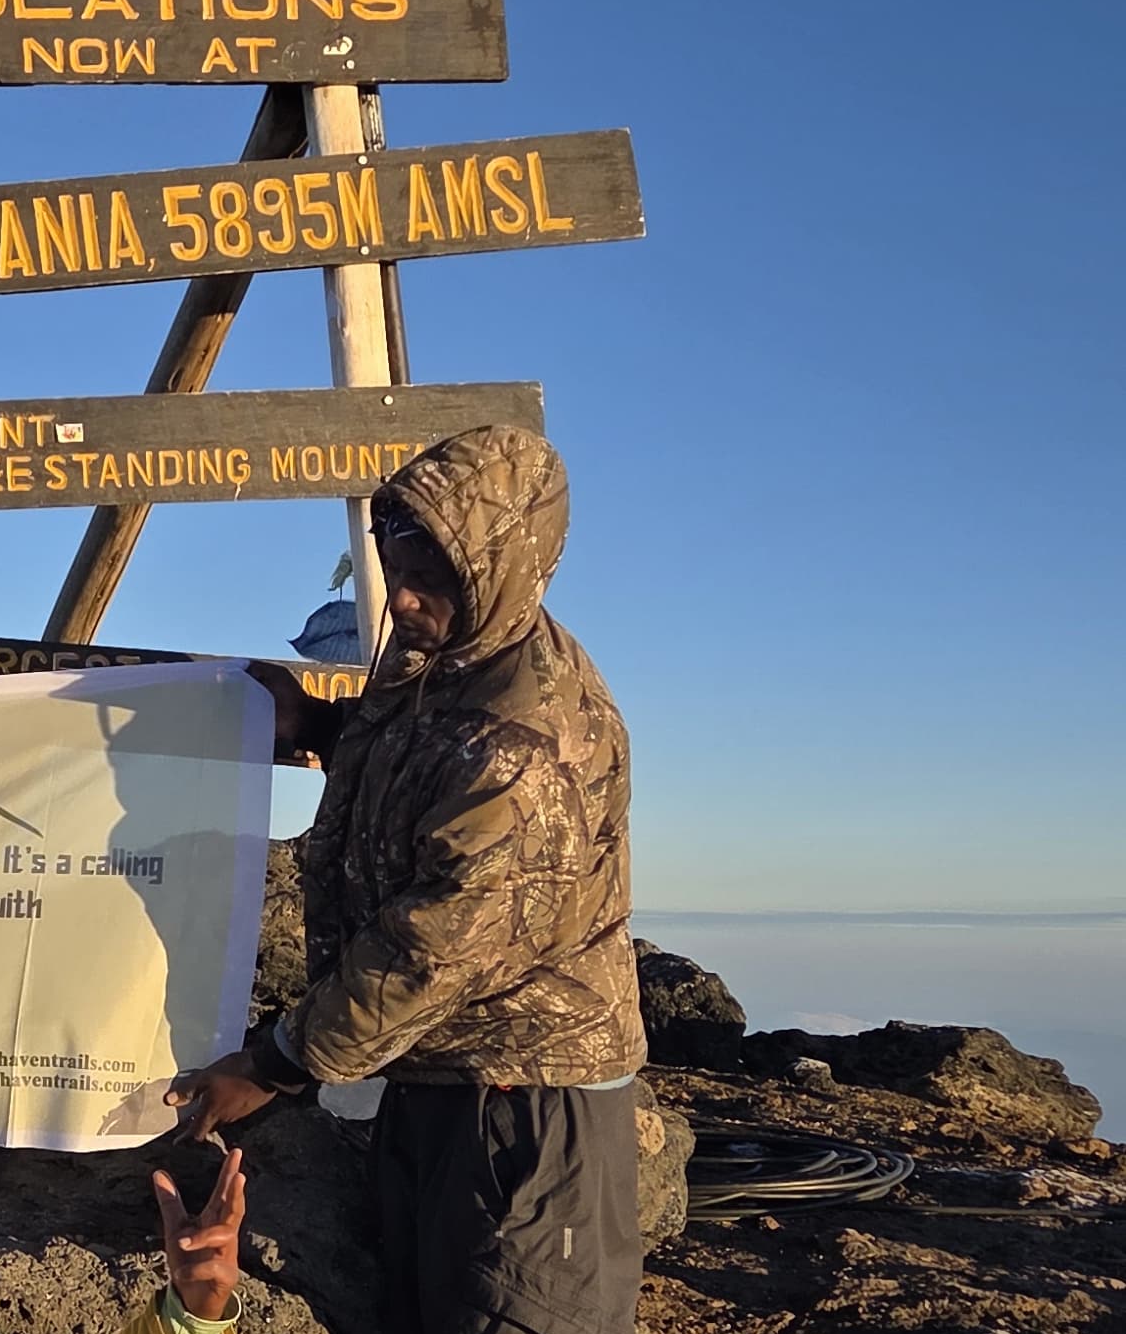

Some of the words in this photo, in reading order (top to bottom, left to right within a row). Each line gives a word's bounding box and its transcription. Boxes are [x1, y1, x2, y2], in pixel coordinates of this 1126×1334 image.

[22, 36, 157, 75] NOW
[200, 36, 277, 75] AT
[162, 167, 385, 262] 5895M
[407, 150, 575, 243] AMSL
[45, 446, 251, 491] STANDING
[270, 441, 425, 483] MOUNT
[2, 845, 46, 874] It's
[56, 854, 72, 875] a
[80, 847, 164, 885] calling
